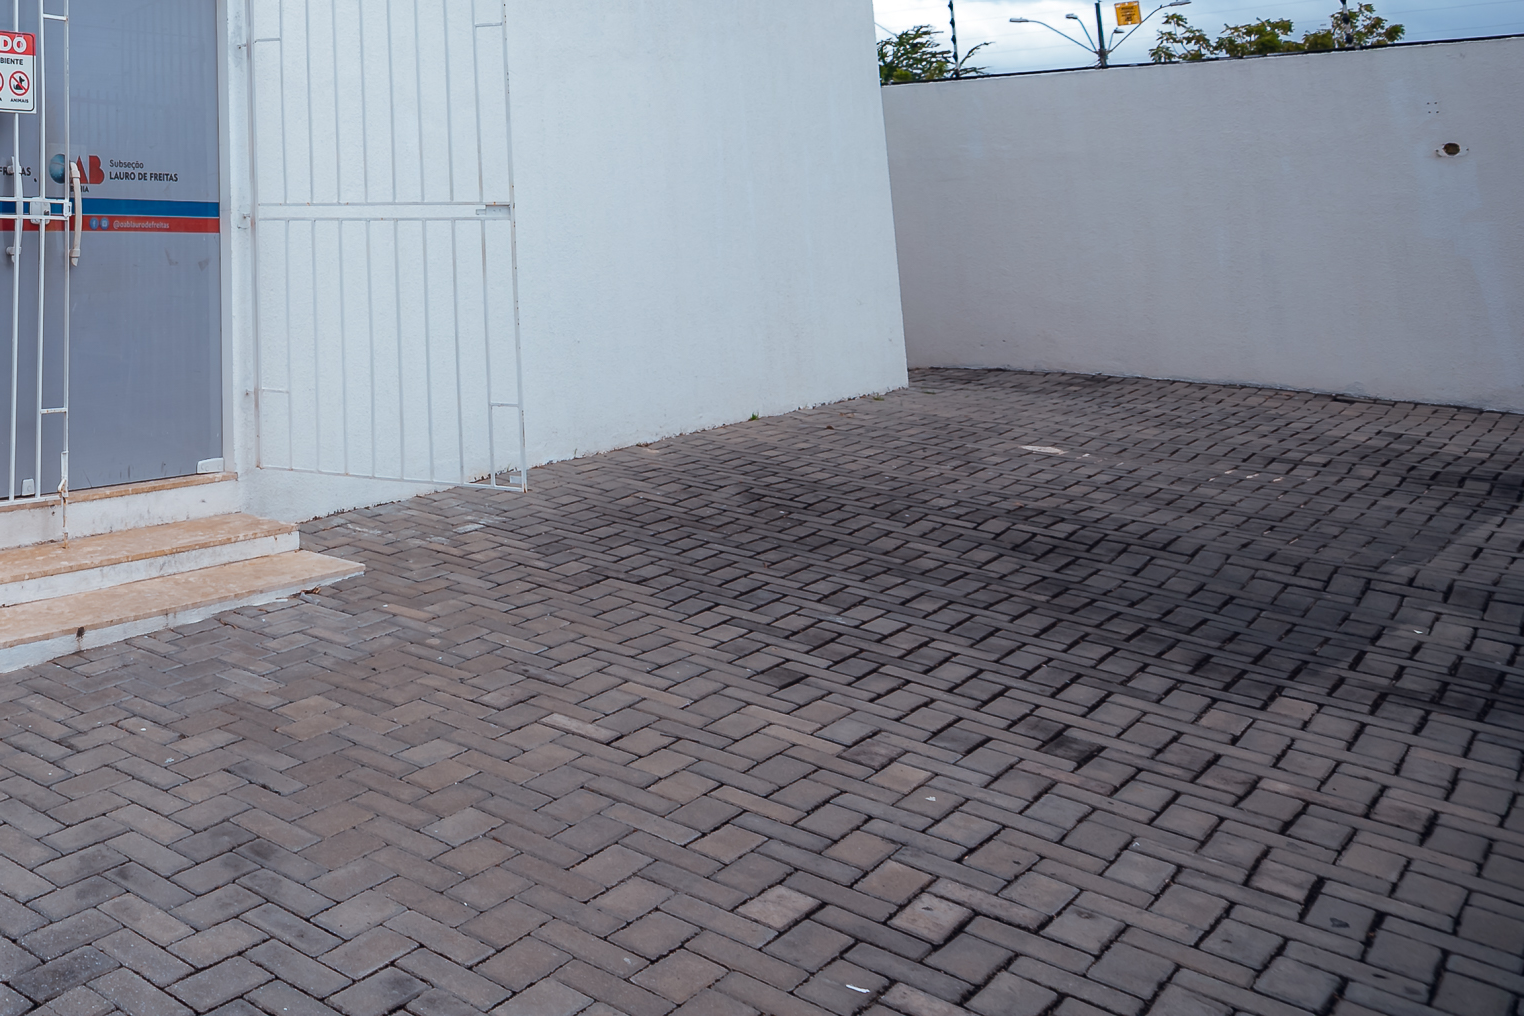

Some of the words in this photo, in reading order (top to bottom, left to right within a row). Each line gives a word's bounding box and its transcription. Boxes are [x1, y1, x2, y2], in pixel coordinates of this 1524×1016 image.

[109, 160, 144, 170] Subseção
[109, 171, 136, 181] LAURO
[138, 172, 148, 181] DE
[150, 172, 179, 182] FREITAS
